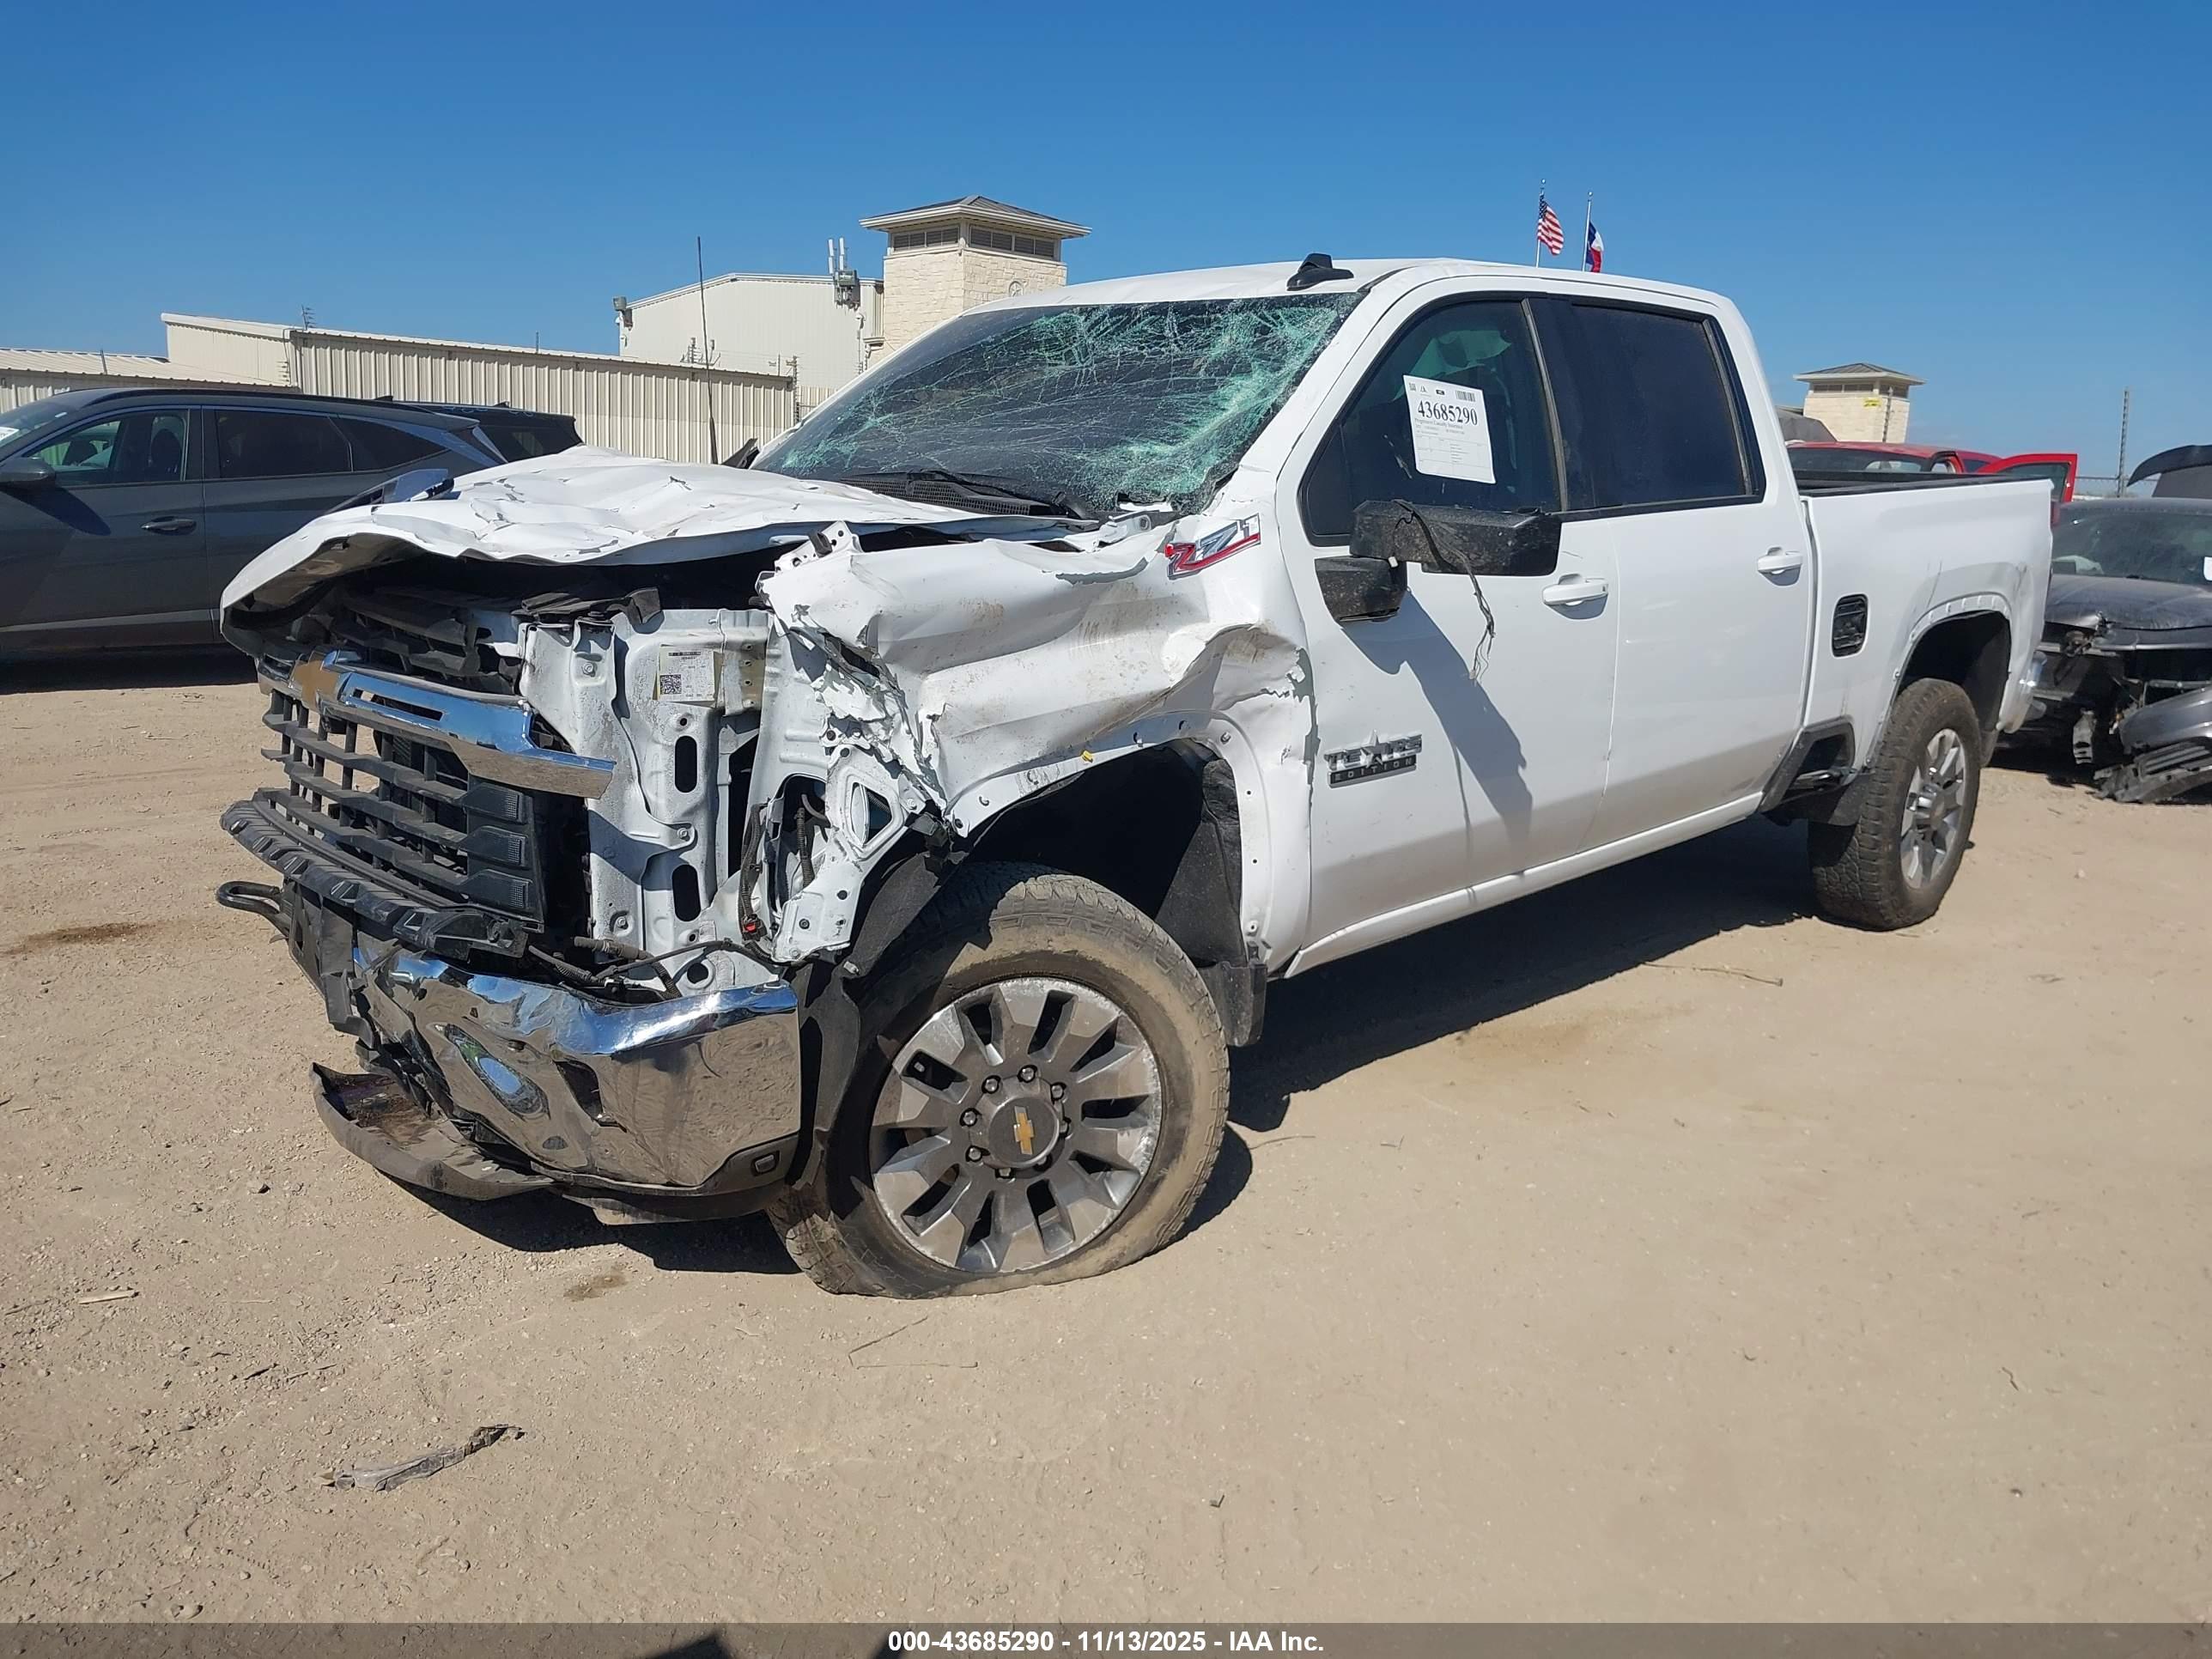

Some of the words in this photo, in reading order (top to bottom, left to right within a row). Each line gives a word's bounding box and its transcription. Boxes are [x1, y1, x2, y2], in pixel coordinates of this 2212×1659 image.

[1418, 400, 1478, 426] 43685290
[1164, 514, 1261, 580] Z71
[1334, 757, 1413, 781] EDITION
